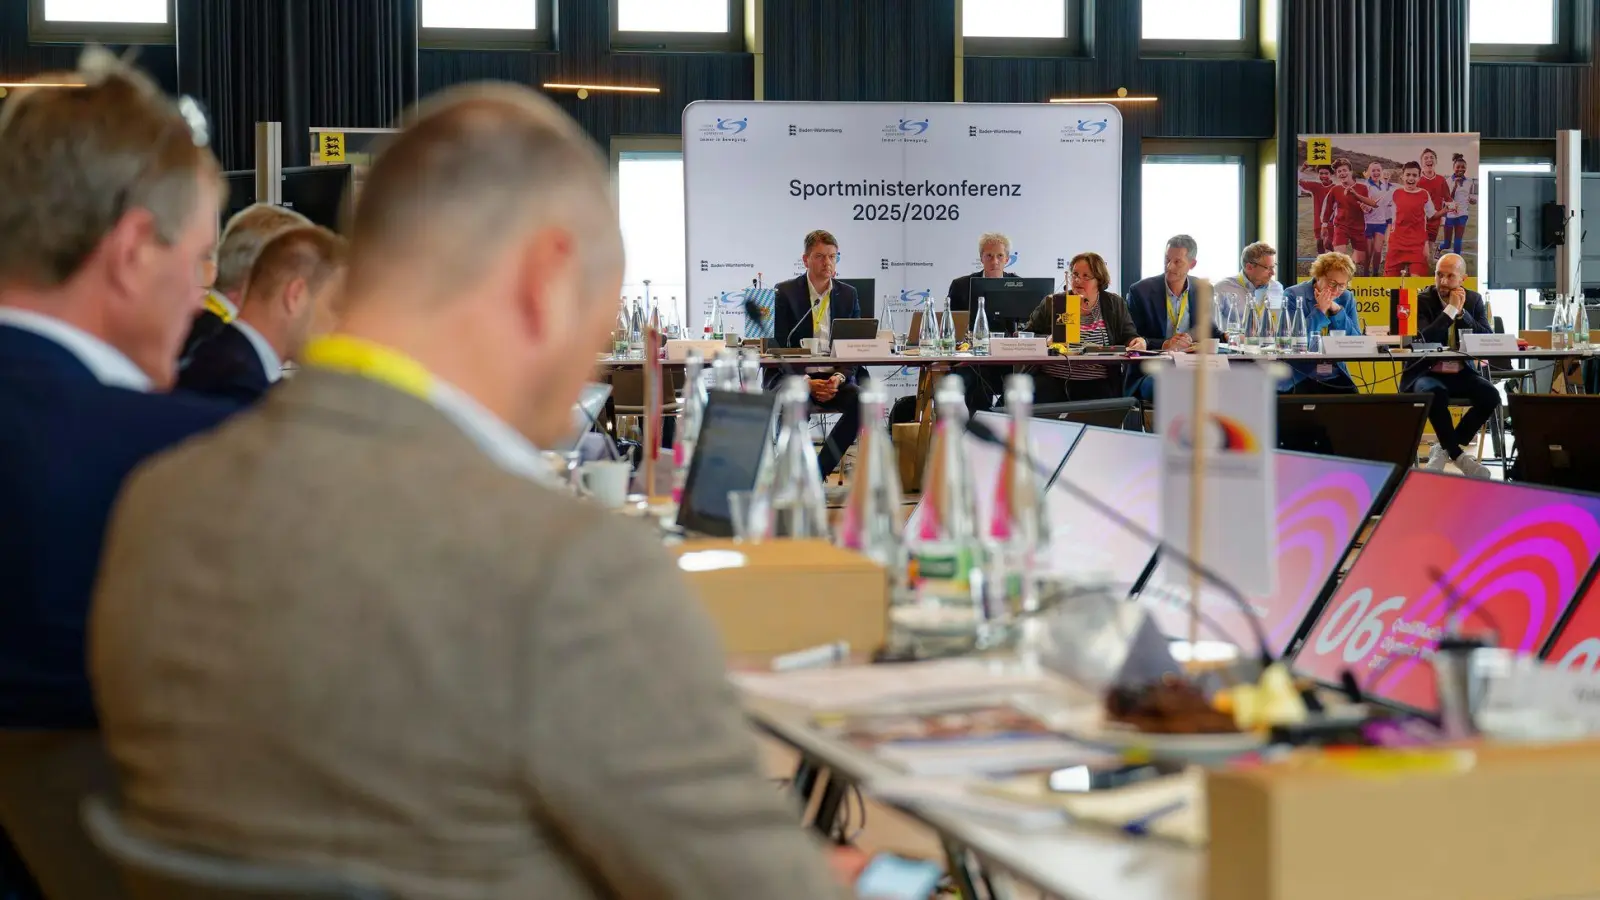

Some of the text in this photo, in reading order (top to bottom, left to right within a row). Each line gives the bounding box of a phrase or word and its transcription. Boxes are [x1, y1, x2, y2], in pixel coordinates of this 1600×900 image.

[789, 179, 1021, 200] Sportministerkonferenz
[853, 203, 960, 222] 2025/2026
[1315, 587, 1406, 663] 06
